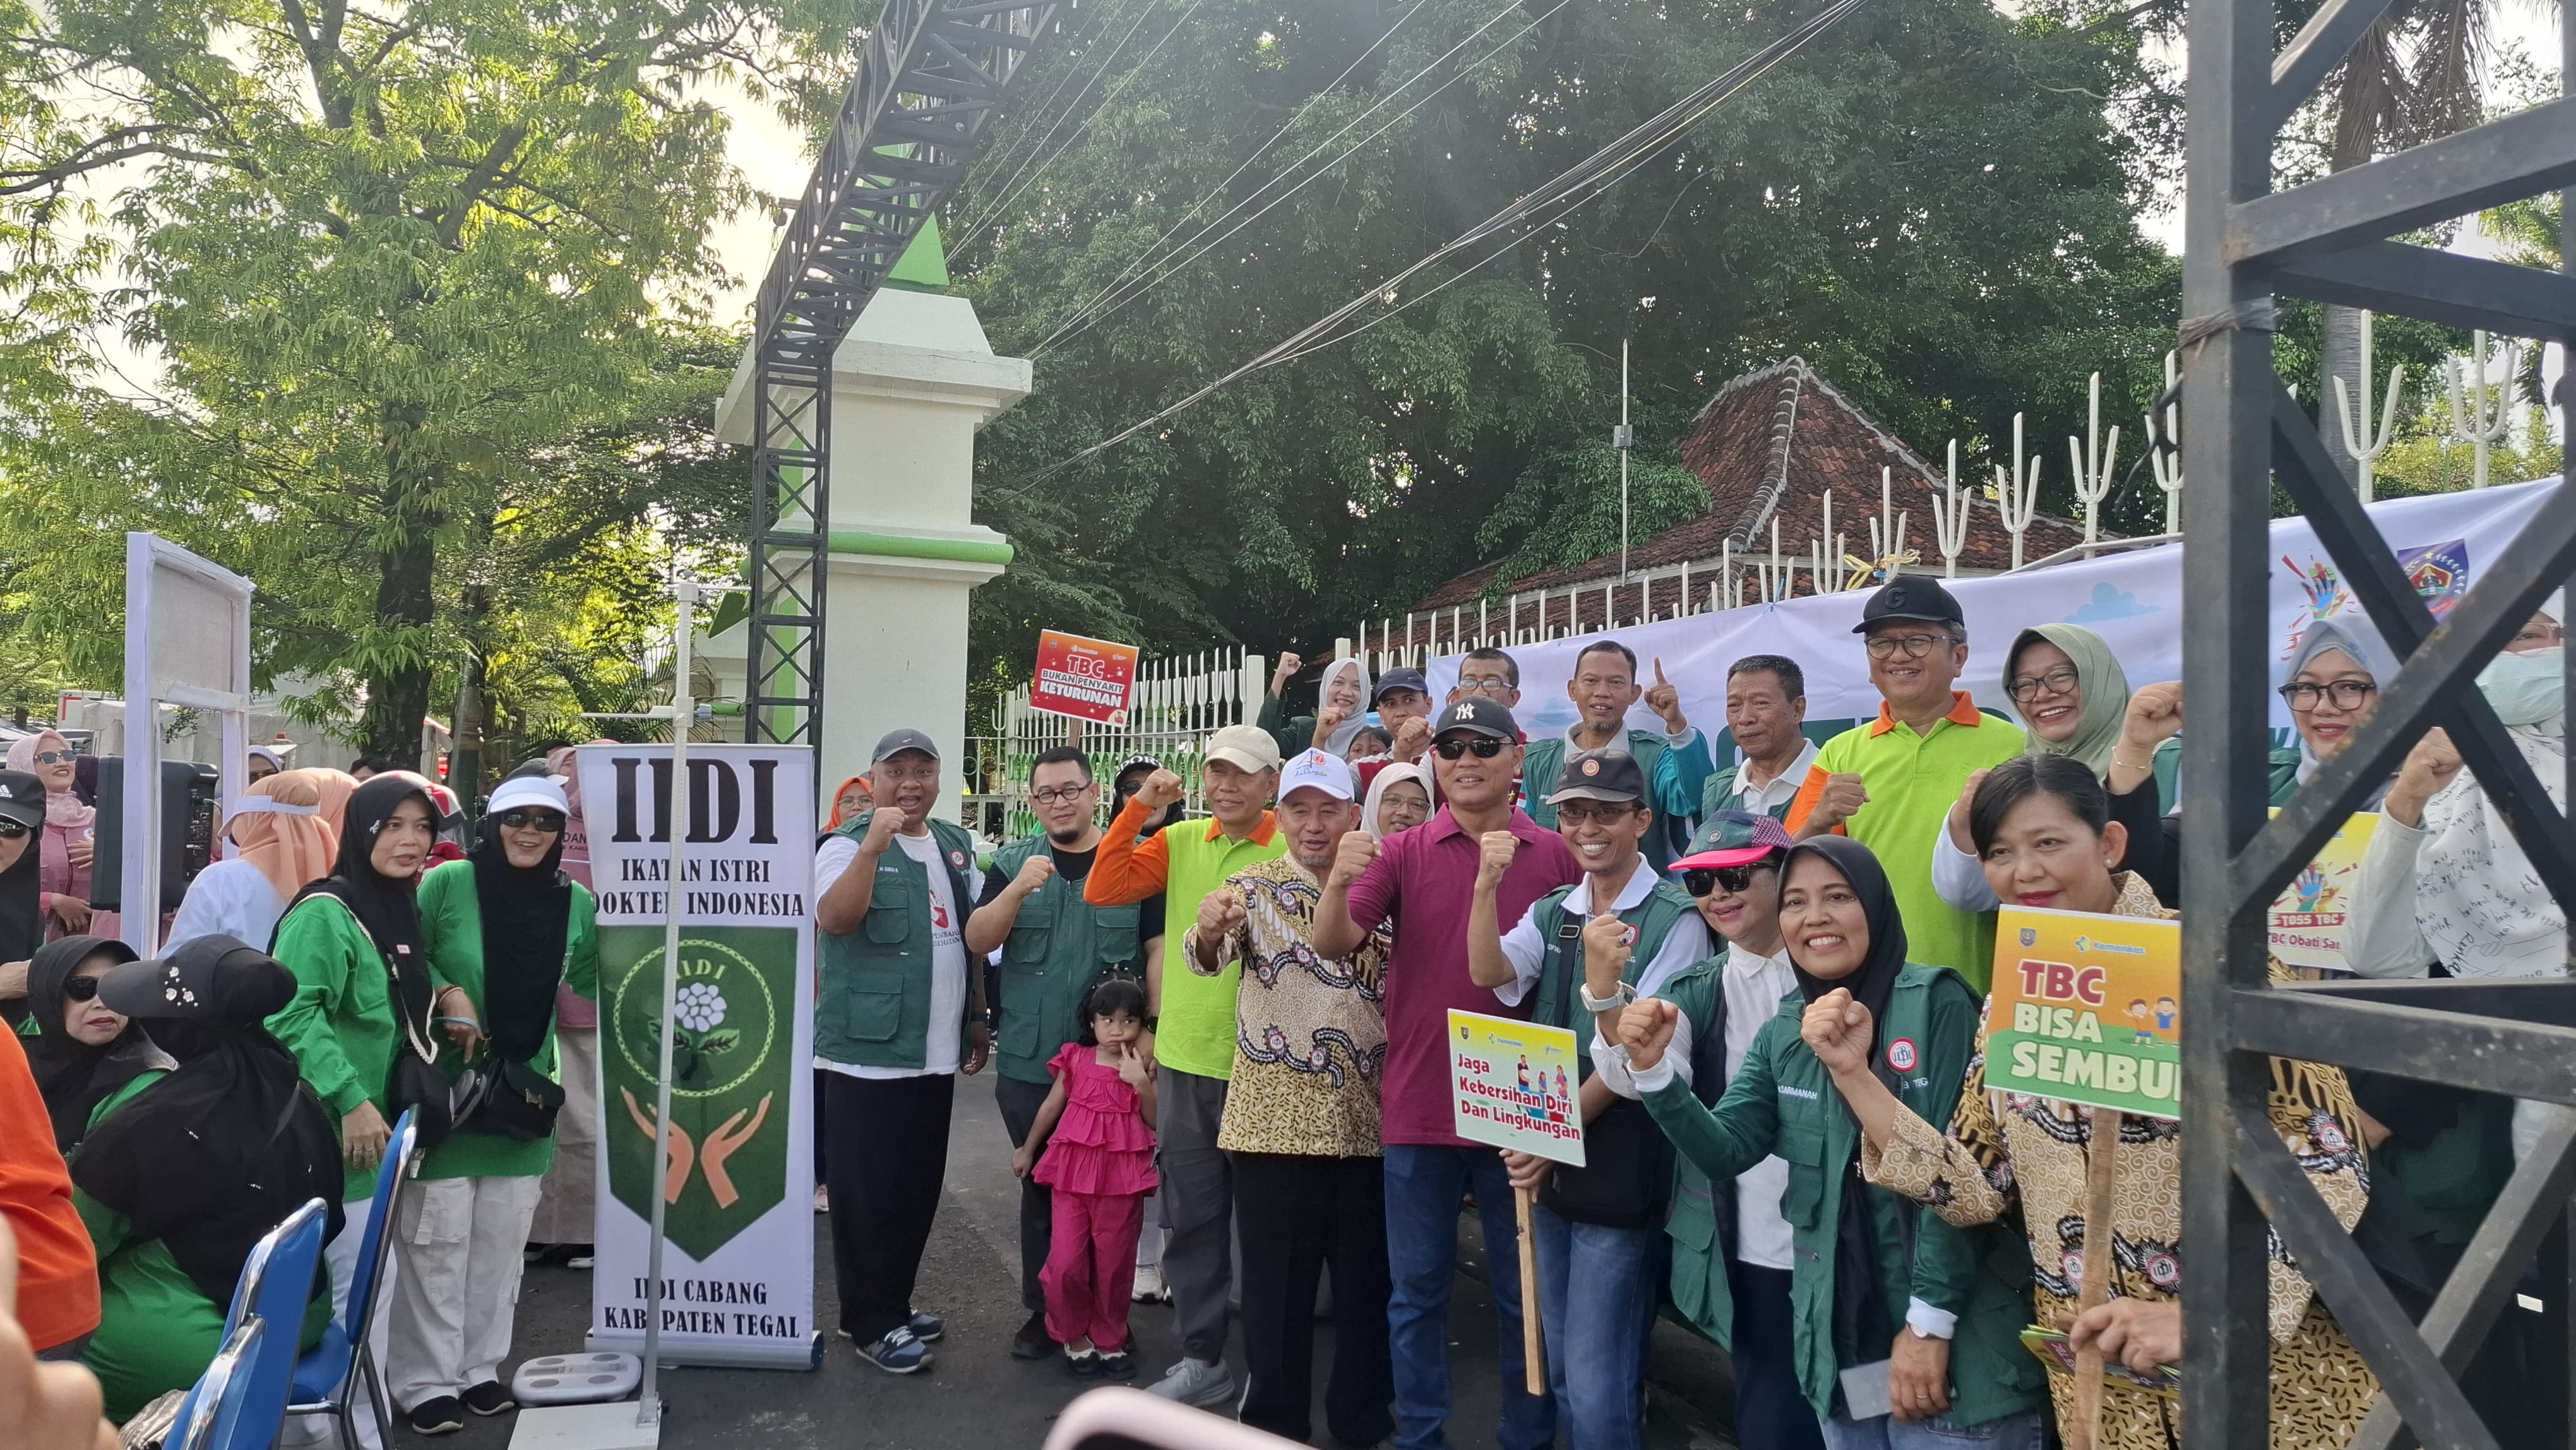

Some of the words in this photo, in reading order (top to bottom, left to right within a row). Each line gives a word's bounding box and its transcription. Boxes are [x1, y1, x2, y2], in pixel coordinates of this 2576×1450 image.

[1067, 654, 1105, 678] TBC
[1042, 669, 1075, 684] BUKAN
[1077, 676, 1124, 693] PENYAKIT
[1040, 681, 1122, 707] KETURUNAN
[611, 757, 778, 844] IIDI
[710, 860, 770, 882] ISTRI
[593, 891, 668, 914] DOKTE
[687, 892, 804, 916] INDONESIA
[2281, 915, 2311, 926] TOSS
[2315, 914, 2339, 925] TBC
[2093, 942, 2145, 954] Kemenkes
[2289, 934, 2319, 947] Obati
[2018, 959, 2106, 1006] TBC
[2013, 1002, 2104, 1044] BISA
[1458, 1053, 1490, 1074] Jaga
[1459, 1076, 1542, 1108] Kebersihan
[1546, 1094, 1573, 1115] Diri
[1461, 1099, 1489, 1119] Dan
[1493, 1106, 1581, 1141] Lingkungan
[684, 1280, 767, 1305] CABANG
[604, 1307, 725, 1334] KABPATEN
[733, 1313, 799, 1338] TEGAL
